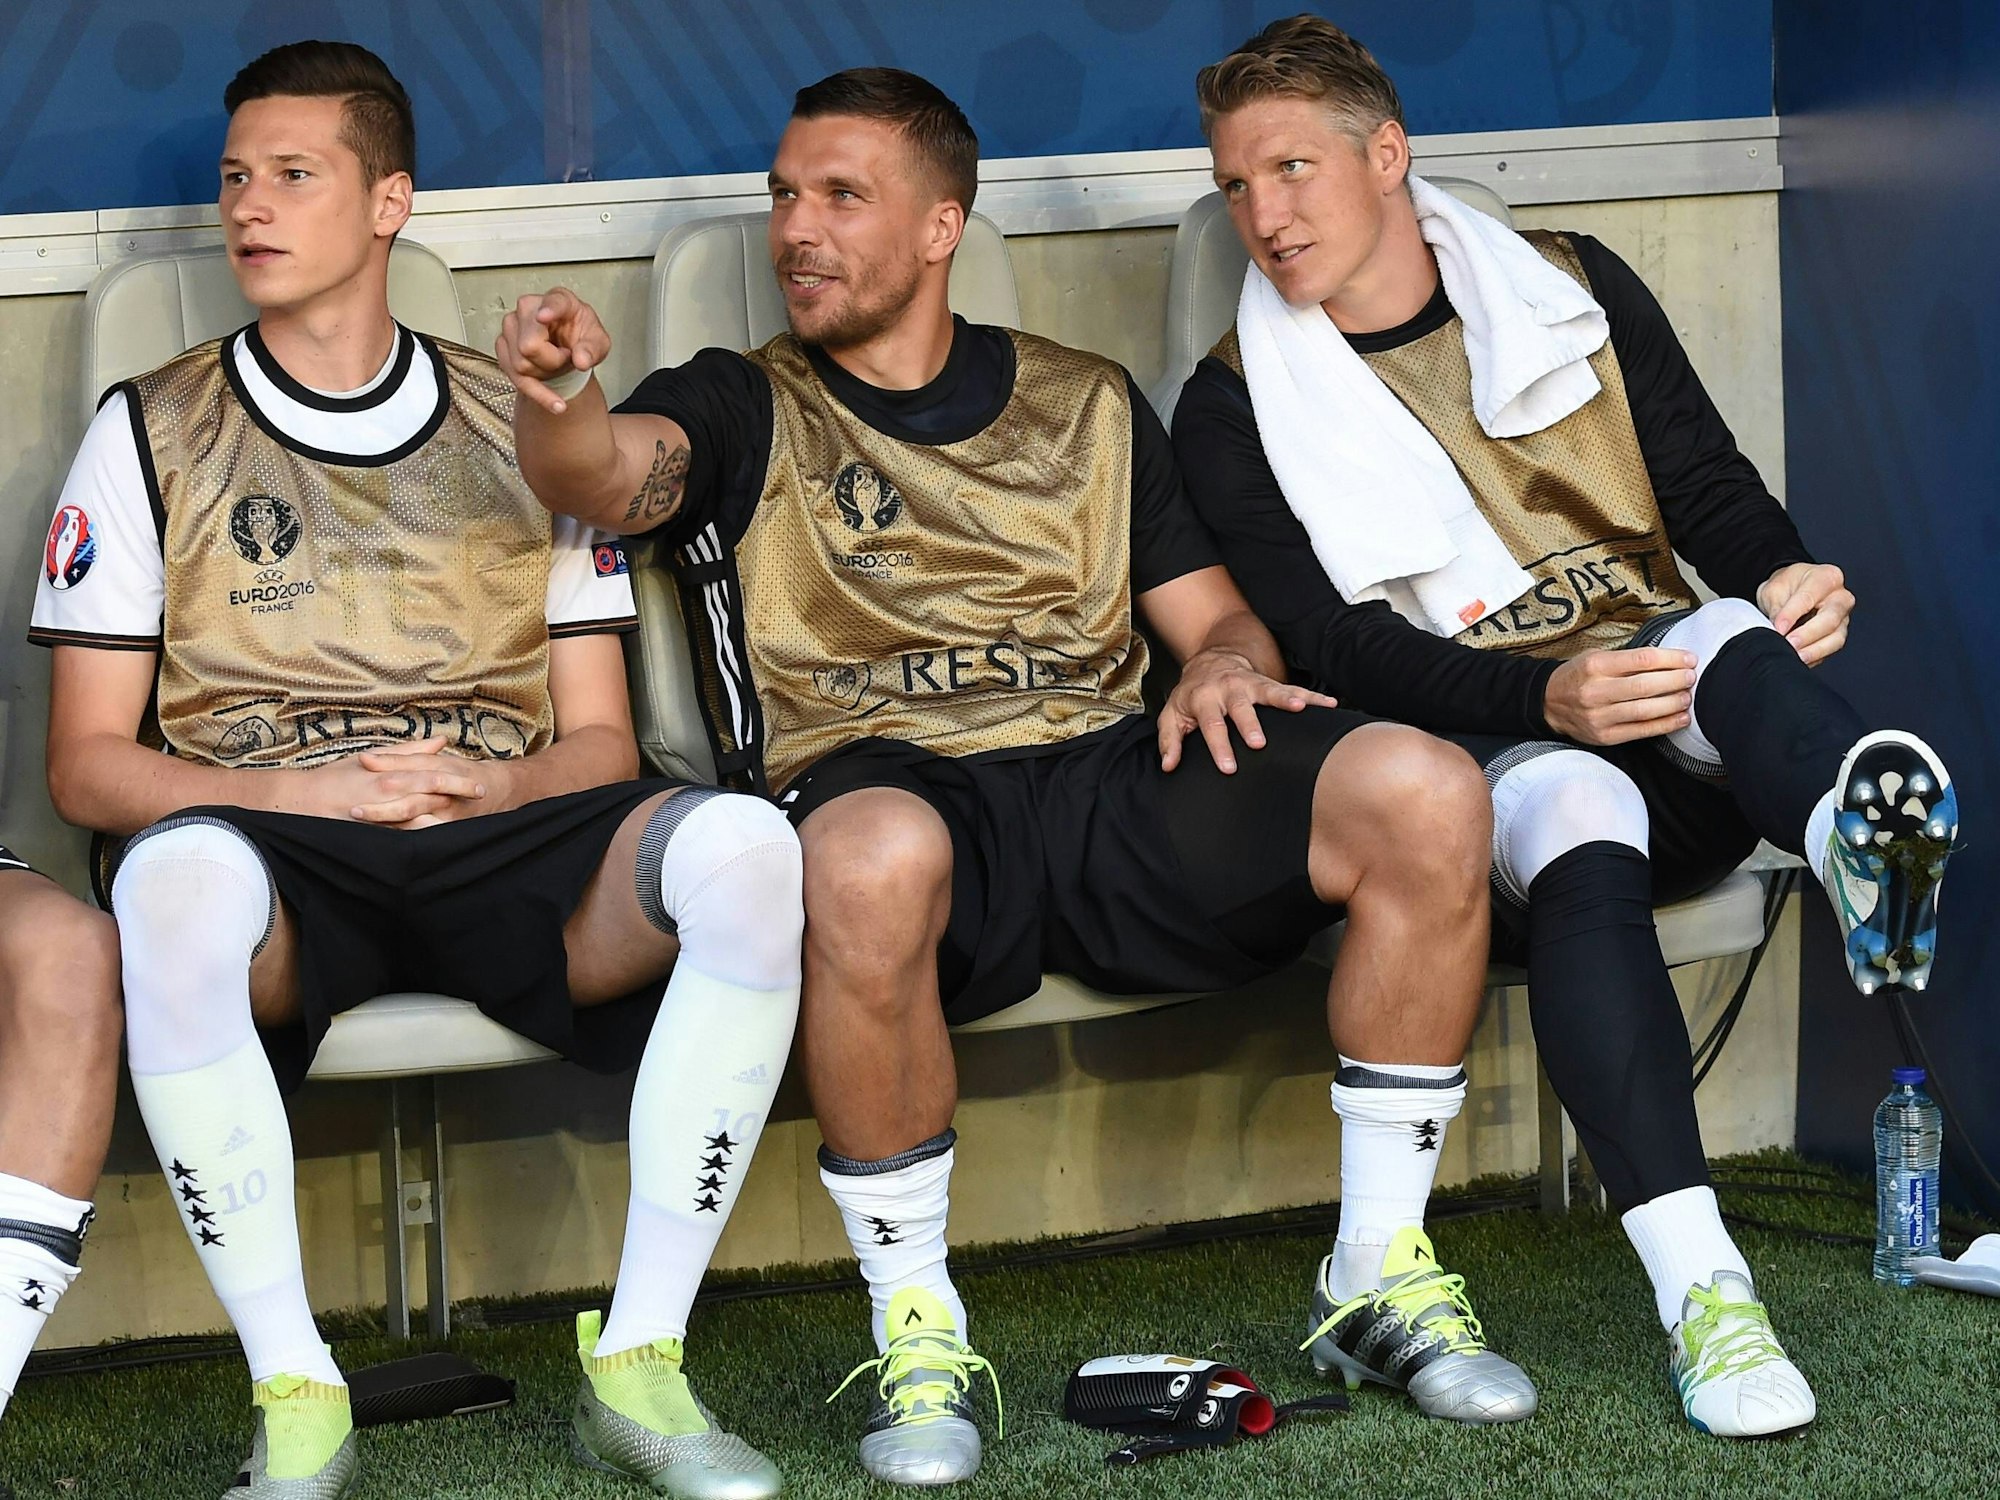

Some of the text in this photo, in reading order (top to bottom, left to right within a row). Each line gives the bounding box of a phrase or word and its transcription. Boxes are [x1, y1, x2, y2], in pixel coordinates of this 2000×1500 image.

[229, 579, 315, 606] EURO2016
[250, 600, 295, 615] FRANCE
[218, 1168, 268, 1215] 10
[1913, 1179, 1925, 1246] Chaudfontaine
